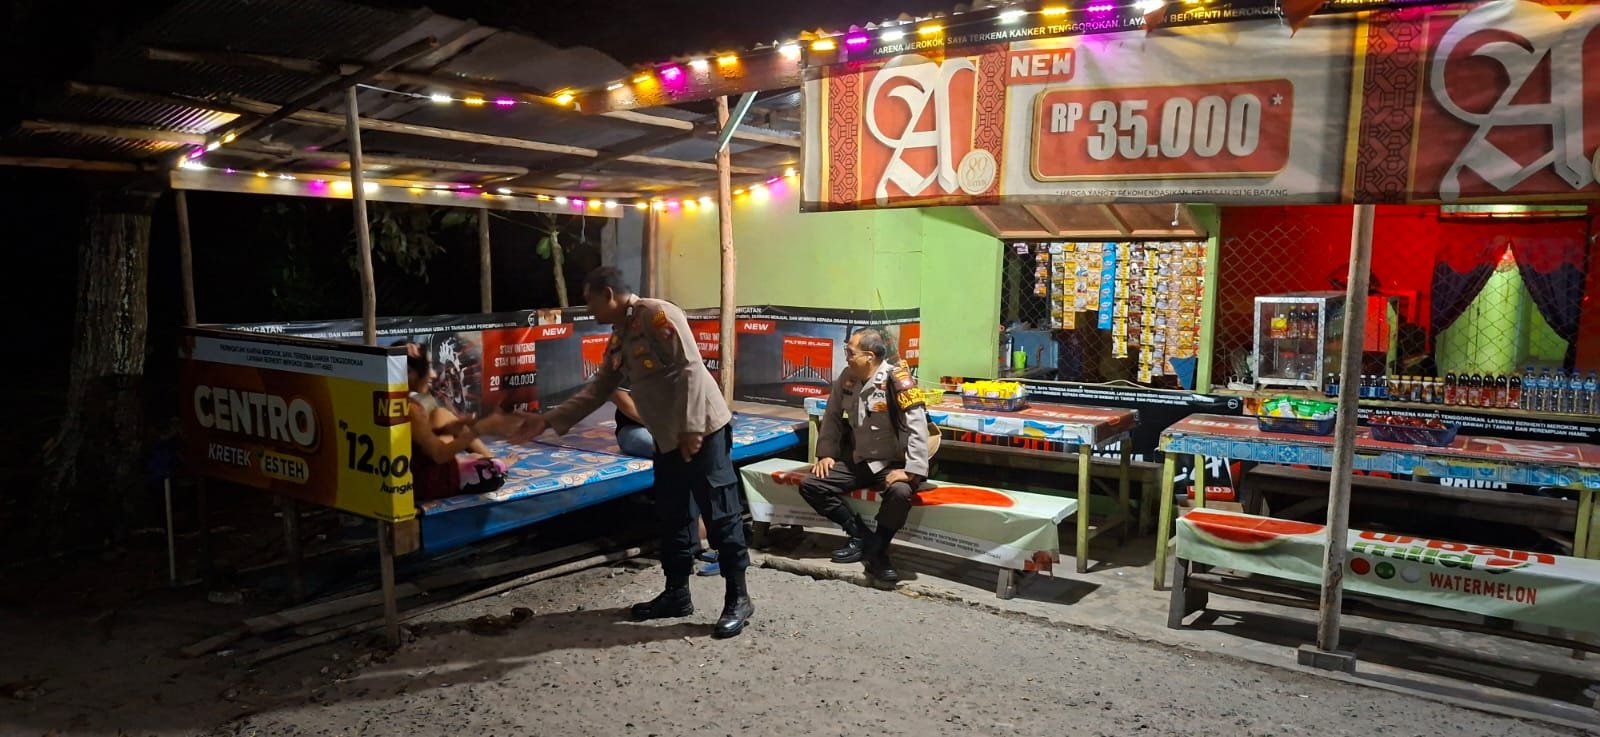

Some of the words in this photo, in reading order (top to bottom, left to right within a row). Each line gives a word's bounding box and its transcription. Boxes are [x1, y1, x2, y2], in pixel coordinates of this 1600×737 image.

[873, 43, 904, 55] KARENA
[947, 36, 968, 45] SAYA
[970, 31, 1008, 42] TERKENA
[1009, 25, 1046, 38] KANKER
[1010, 52, 1072, 78] NEW
[1051, 103, 1083, 133] RP
[1087, 93, 1262, 161] 35.000
[1253, 188, 1288, 197] BATANG
[542, 327, 567, 337] NEW
[743, 323, 769, 331] NEW
[490, 375, 500, 387] 20
[792, 386, 822, 394] MOTION
[194, 384, 316, 446] CENTRO
[208, 442, 252, 467] KRETEK
[345, 430, 413, 478] 12.00
[1429, 571, 1537, 605] WATERMELON
